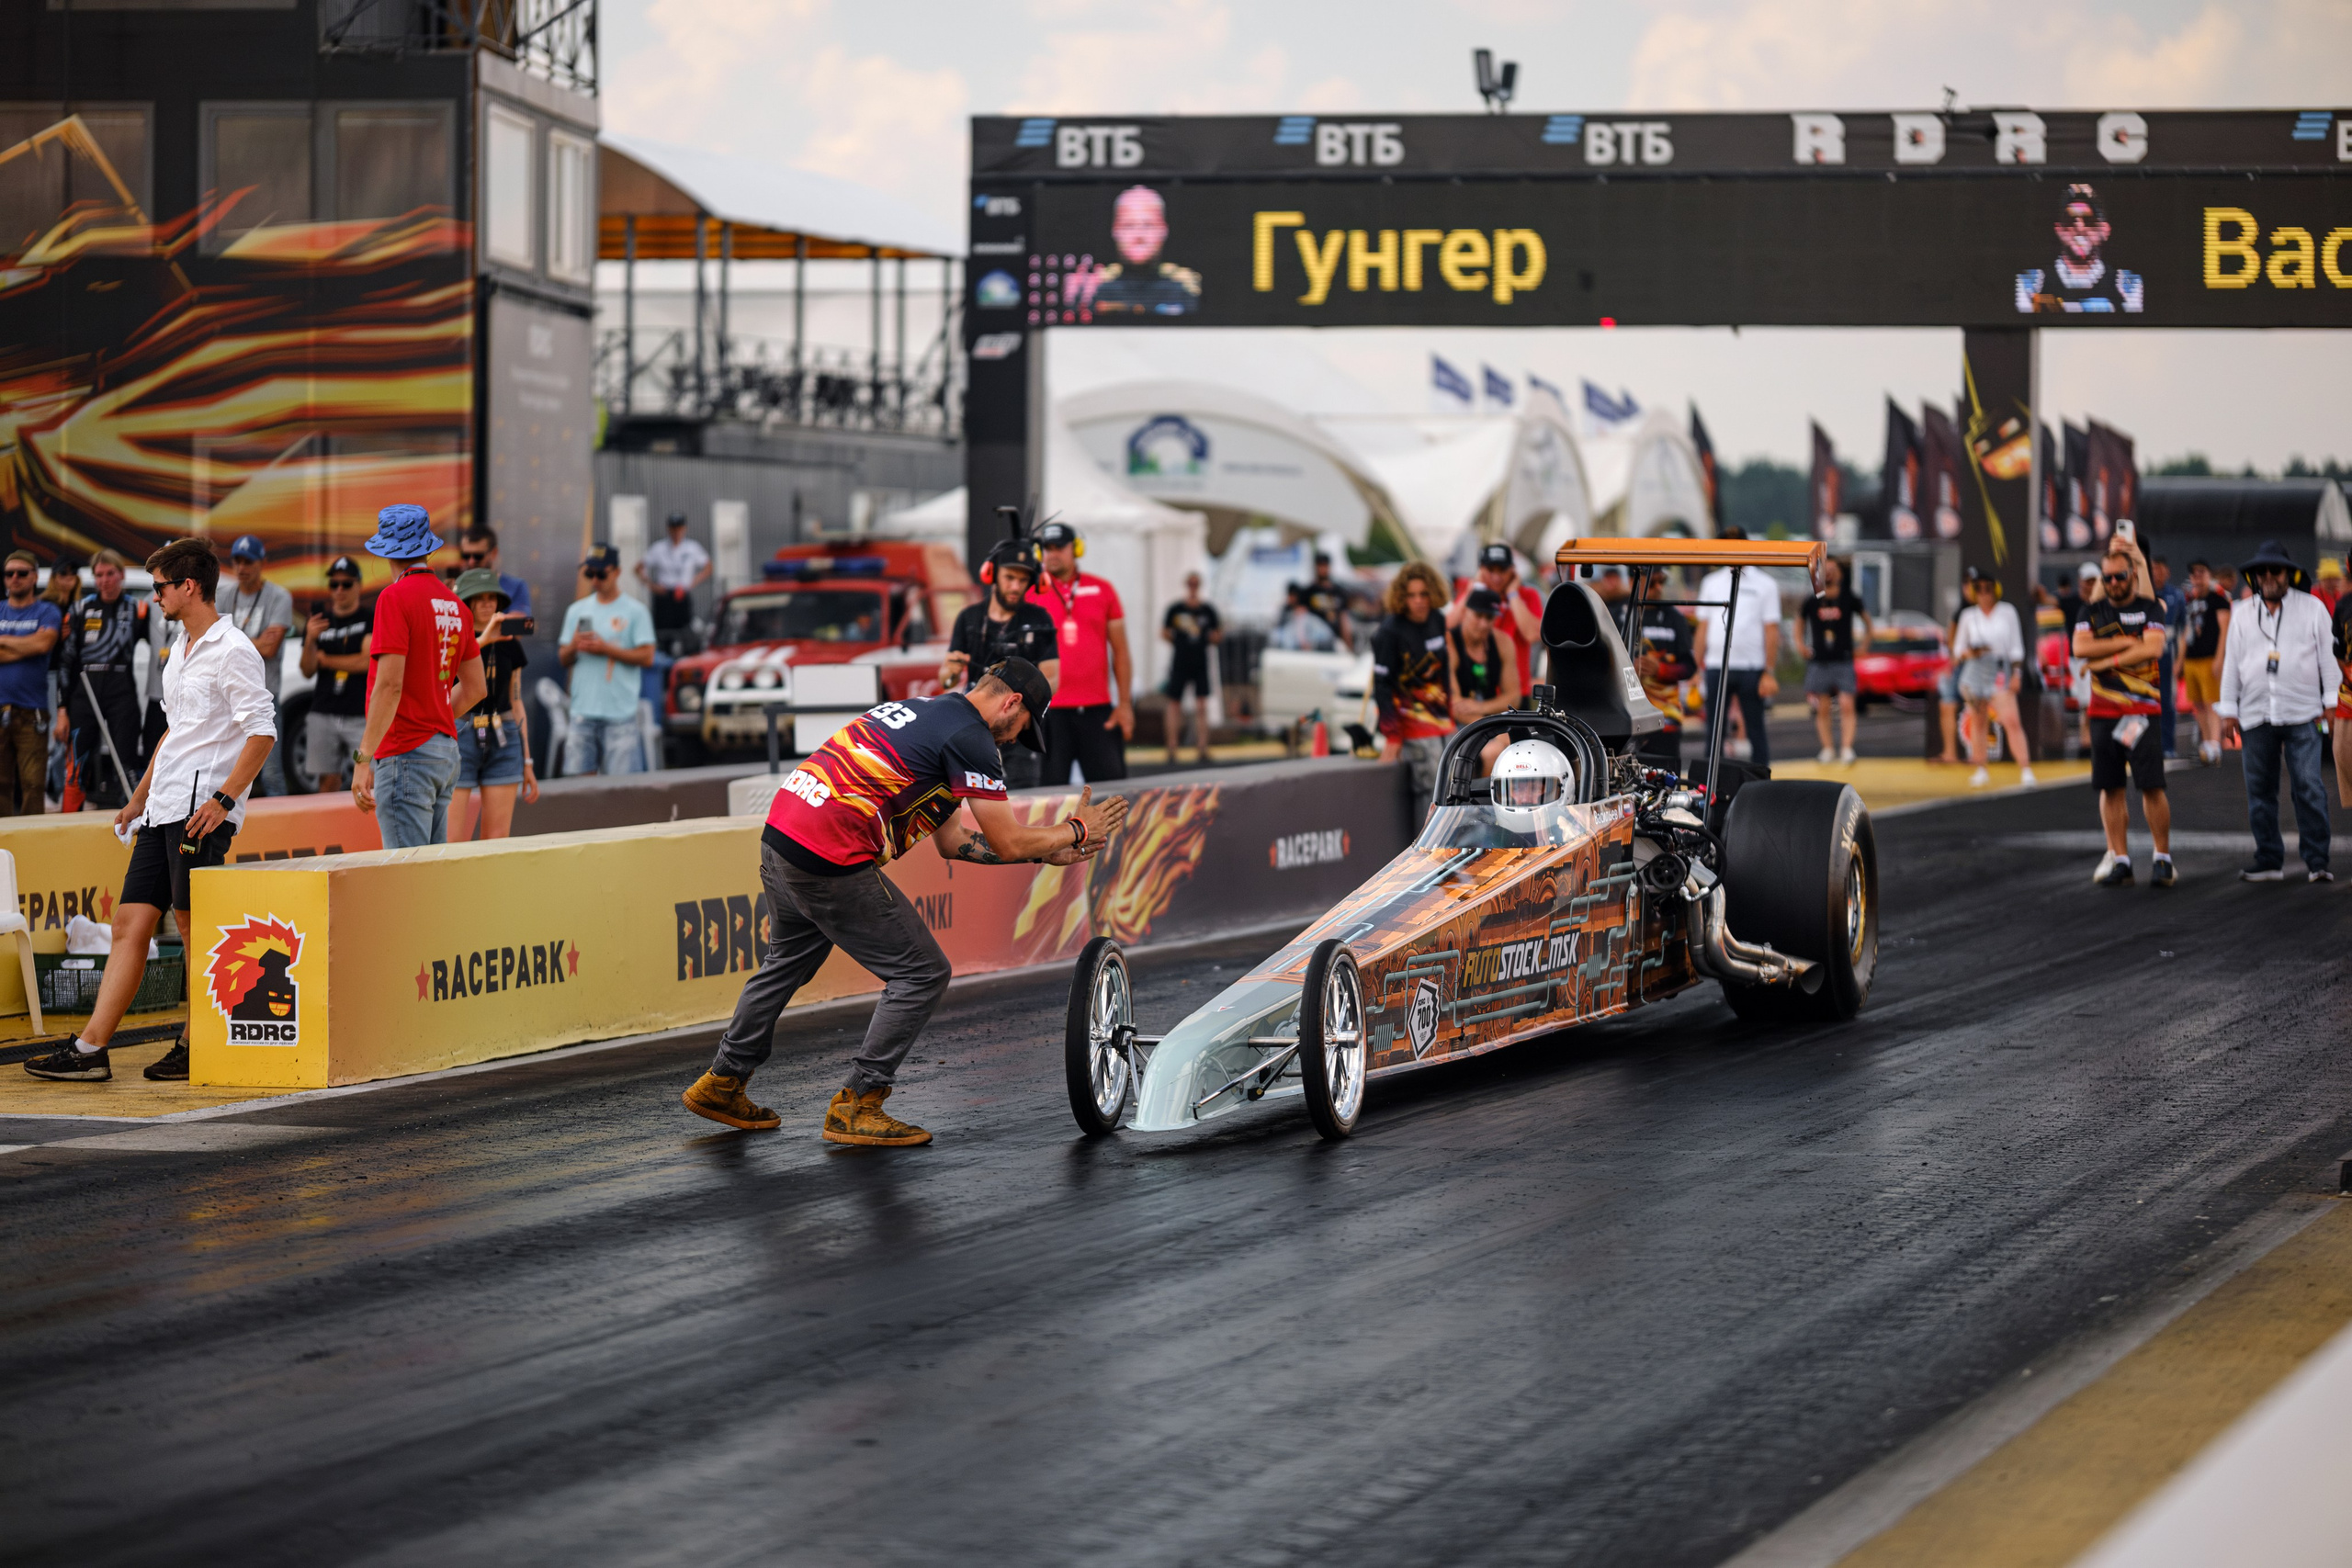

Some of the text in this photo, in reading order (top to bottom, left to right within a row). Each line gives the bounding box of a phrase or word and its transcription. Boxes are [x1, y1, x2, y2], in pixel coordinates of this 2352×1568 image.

[1056, 125, 1145, 168] ВТБ
[1315, 122, 1406, 166] ВТБ
[1584, 120, 1674, 165] ВТБ
[1252, 211, 1547, 305] Гунгер
[866, 701, 918, 729] 33
[1277, 829, 1344, 870] RACEPARK
[432, 940, 565, 1002] RACEPARK
[230, 1023, 297, 1041] RDRC
[1417, 1004, 1432, 1032] 700
